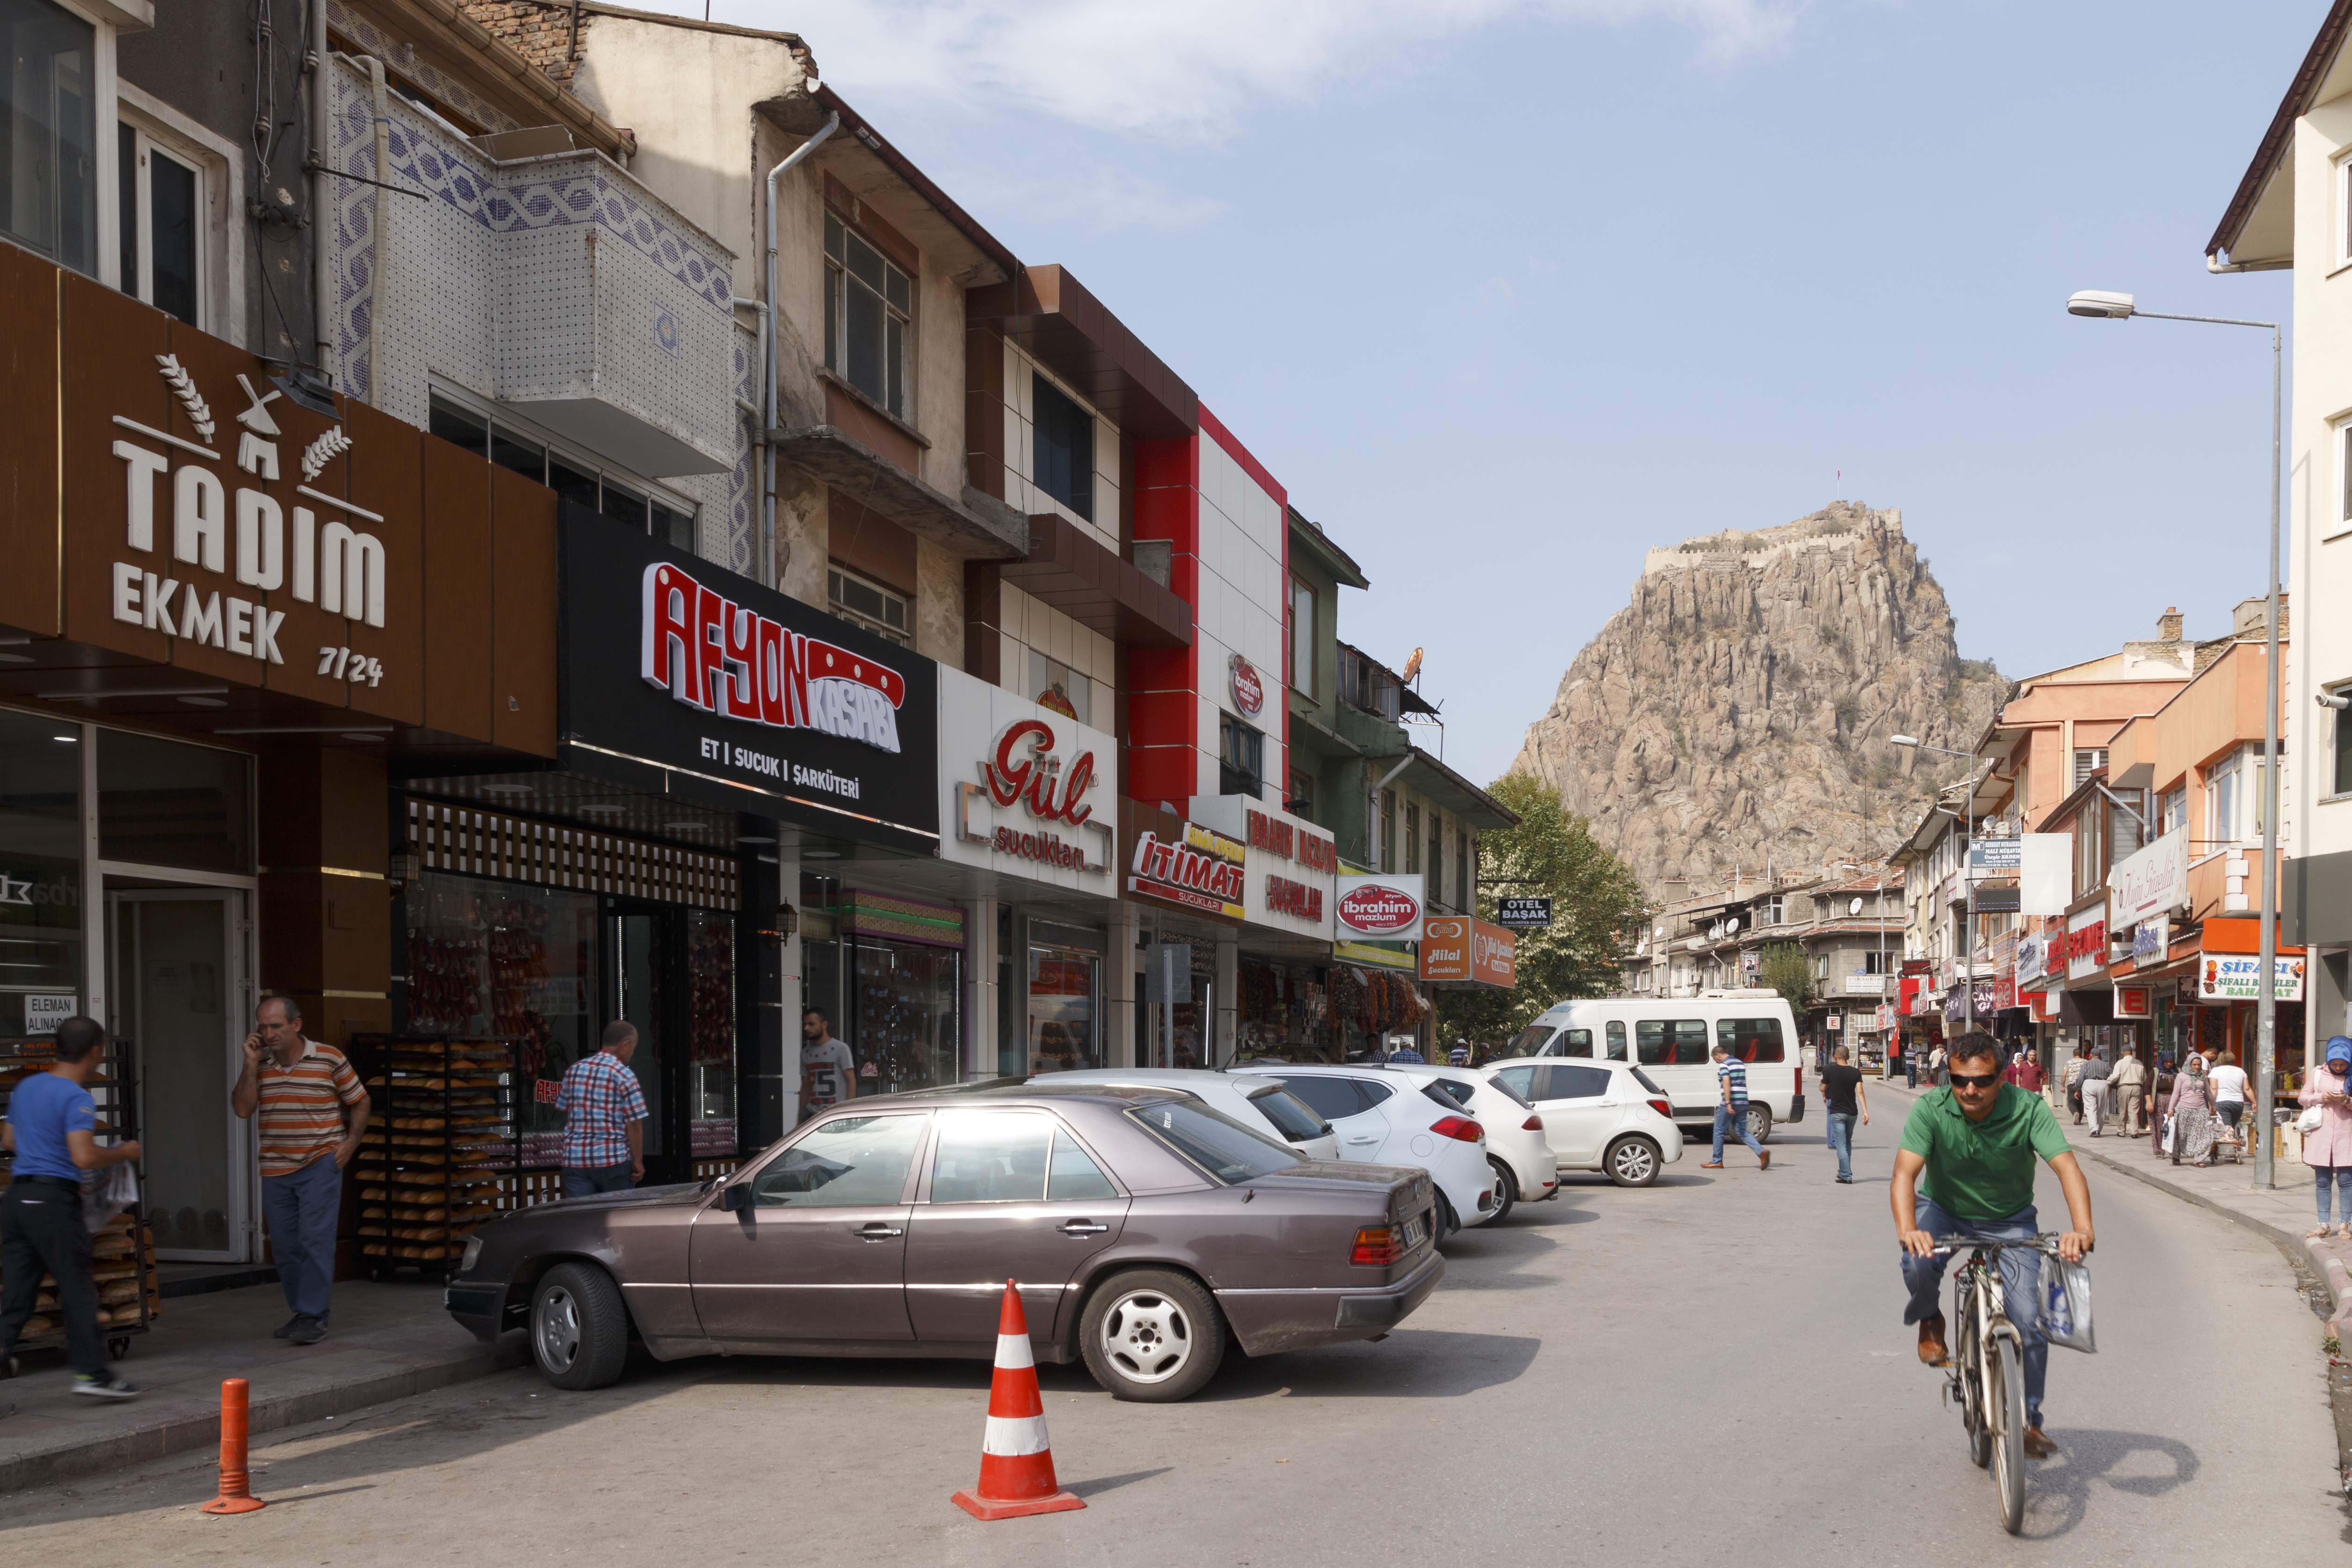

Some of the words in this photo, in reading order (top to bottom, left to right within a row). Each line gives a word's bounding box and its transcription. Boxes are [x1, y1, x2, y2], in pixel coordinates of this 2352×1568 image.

[113, 440, 385, 628] TADIM
[113, 562, 286, 665] EKMEK
[642, 562, 811, 729] AFYON
[317, 646, 384, 688] 7/24
[1235, 670, 1260, 699] ibrahim
[1240, 690, 1254, 704] mazlum
[807, 678, 901, 754] KASABI
[701, 737, 719, 760] ET
[734, 748, 780, 778] SUCUK
[793, 764, 860, 799] ŞARKÜTERİ
[977, 719, 1094, 828] Gül
[1183, 822, 1214, 852] İSMAİL
[1248, 809, 1293, 860] İBRAHİM
[1295, 828, 1336, 875] MAZLUM
[992, 826, 1086, 872] sucukları
[1132, 831, 1245, 900] İTİMAT
[2144, 845, 2177, 898] Güzellik
[1178, 892, 1220, 910] SUCUKLARI
[1266, 874, 1322, 923] SUCUKLARI
[1344, 900, 1411, 913] ibrahim
[1507, 900, 1543, 909] OTEL
[1355, 913, 1396, 921] mazlum
[1502, 910, 1547, 920] BAŞAK
[1436, 925, 1454, 935] Hilal
[1427, 949, 1461, 964] Hilal
[1428, 966, 1461, 975] Sucukları
[2217, 976, 2250, 987] ŞİFALI
[2251, 977, 2298, 987] BİLER
[1972, 991, 1993, 1002] ÇAN
[2125, 991, 2143, 1011] E
[2225, 987, 2294, 997] BAHAAT
[32, 998, 71, 1012] ELEMAN
[28, 1017, 63, 1031] ALINAC
